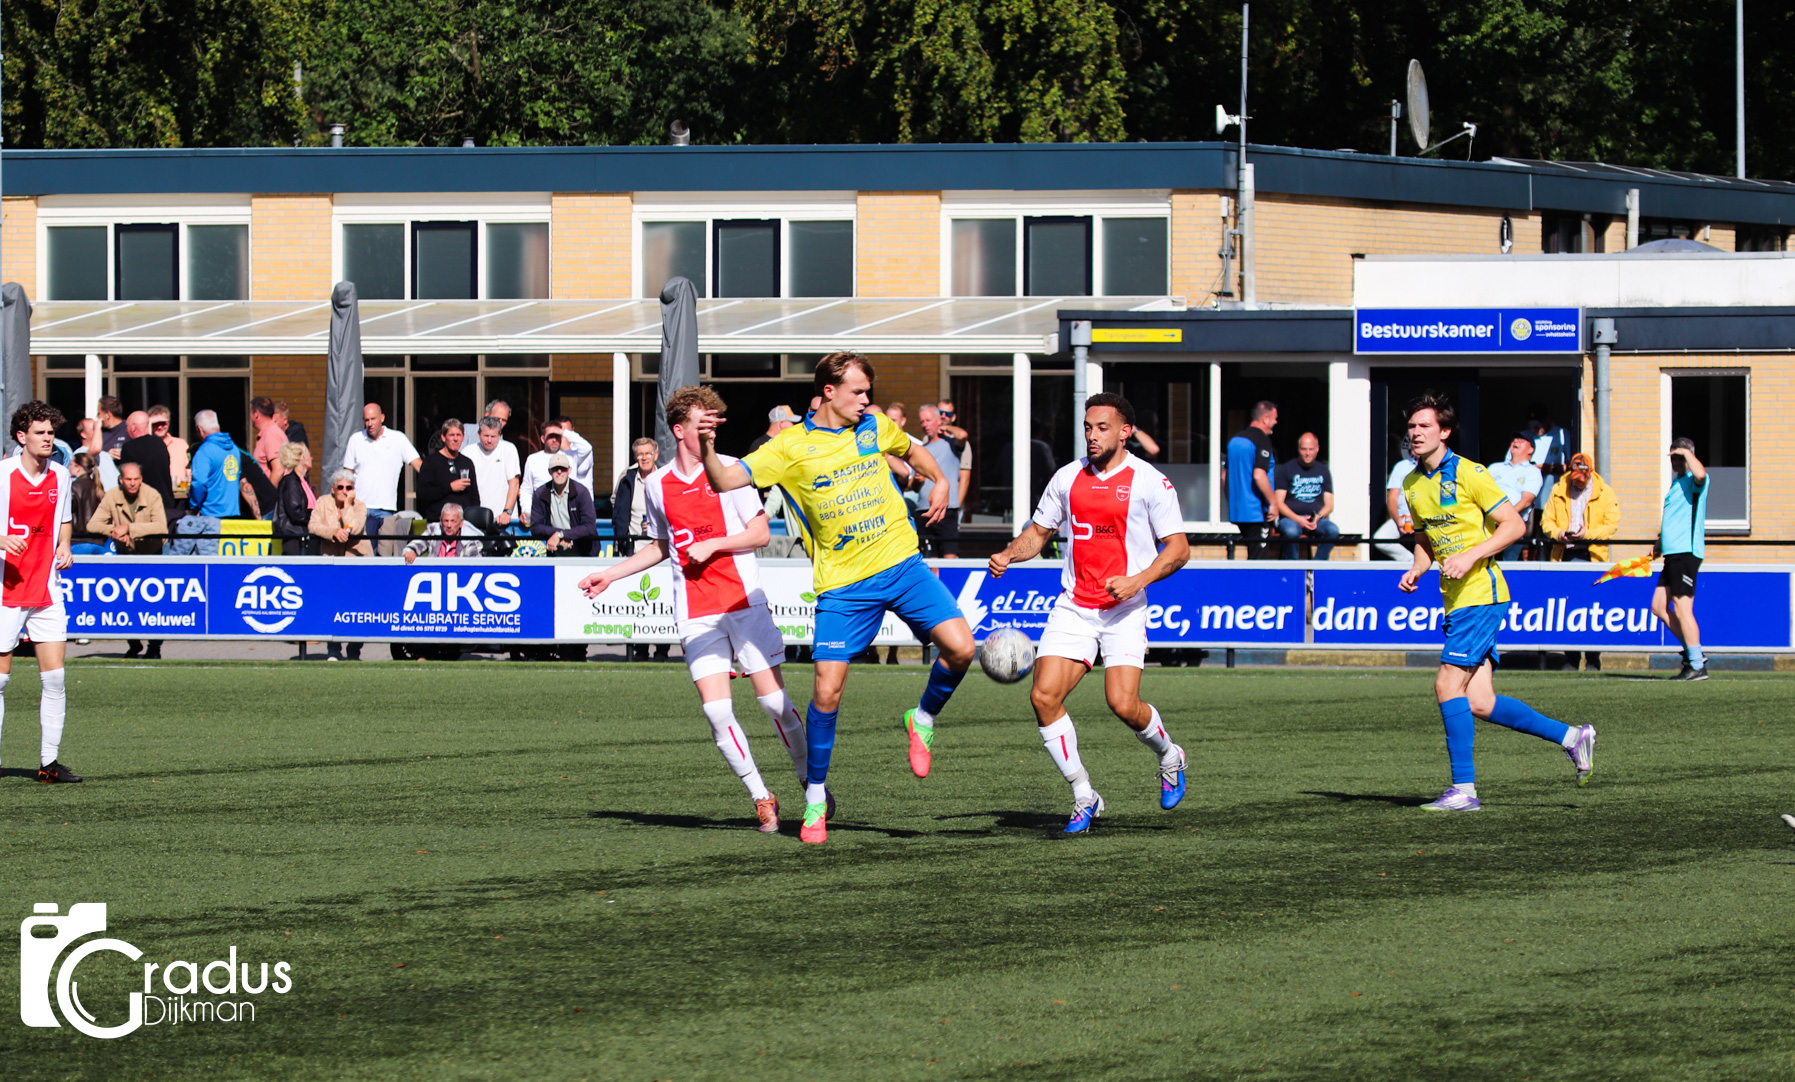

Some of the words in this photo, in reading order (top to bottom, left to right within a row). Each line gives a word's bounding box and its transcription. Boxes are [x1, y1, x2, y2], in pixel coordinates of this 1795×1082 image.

[1360, 321, 1494, 339] Bestuurskamer
[1535, 322, 1576, 332] sponsoring
[833, 458, 878, 479] BASTIAAN
[819, 510, 837, 521] BBQ
[846, 496, 885, 514] CATERING
[693, 524, 713, 535] B&G
[843, 523, 858, 535] VAN
[859, 514, 886, 533] ERVEN
[1095, 525, 1115, 534] B&G
[234, 585, 303, 610] AKS
[403, 571, 521, 613] AKS
[591, 601, 646, 618] Streng
[1200, 604, 1294, 630] meer
[1312, 597, 1378, 631] dan
[76, 611, 96, 627] de
[101, 611, 133, 627] N.O.
[138, 611, 196, 627] Veluwe!
[333, 612, 400, 624] AGTERHUIS
[403, 613, 470, 625] KALIBRATIE
[473, 613, 521, 626] SERVICE
